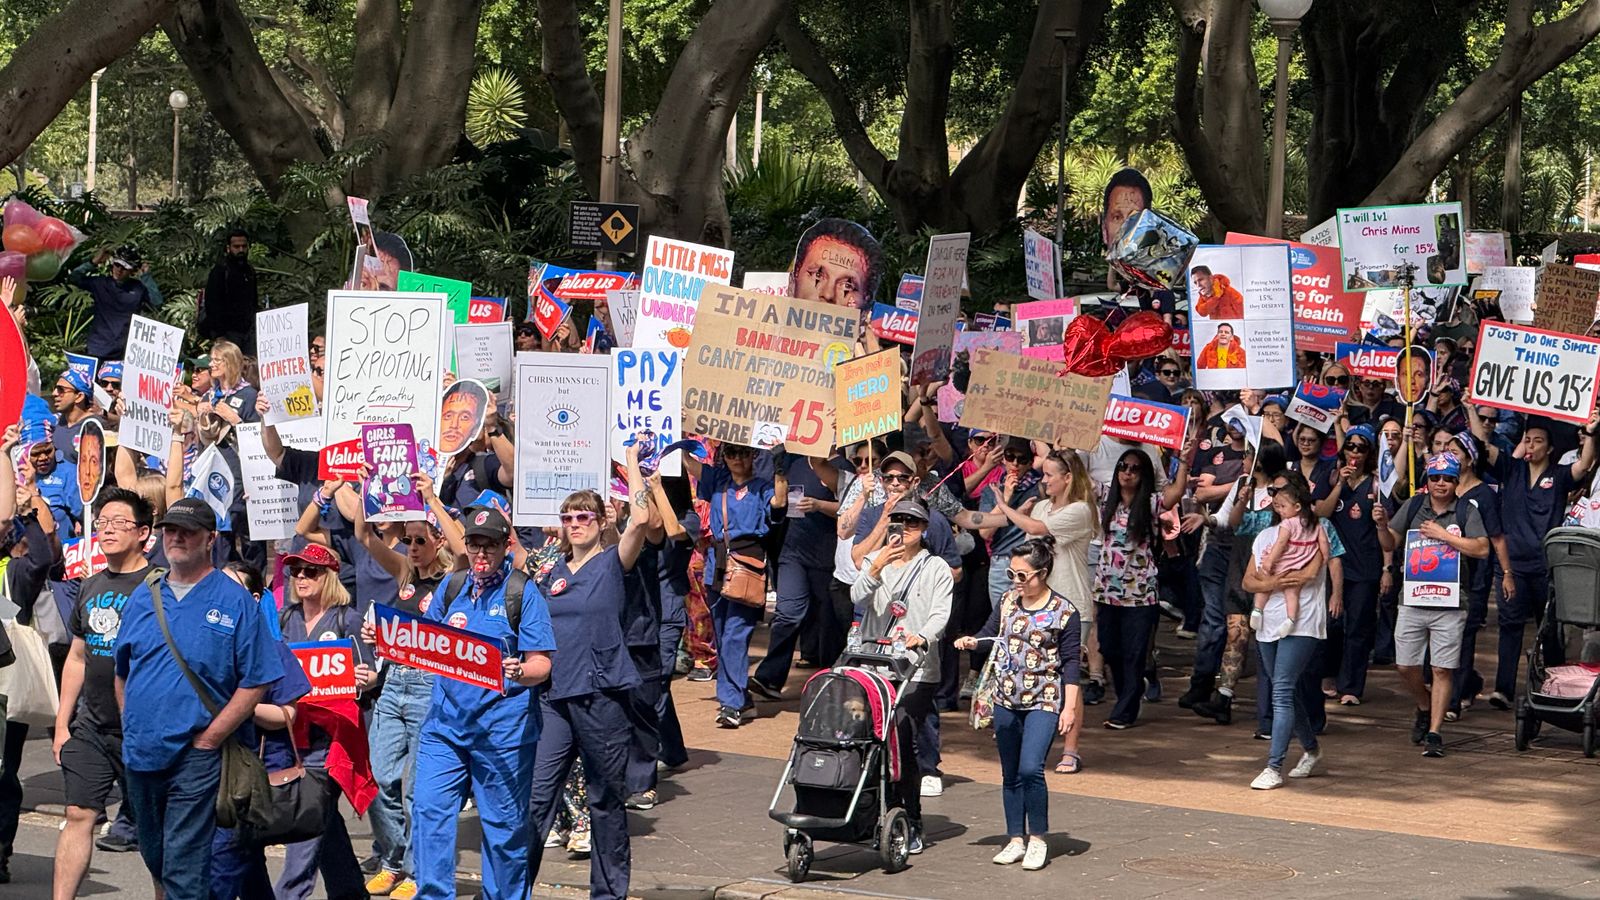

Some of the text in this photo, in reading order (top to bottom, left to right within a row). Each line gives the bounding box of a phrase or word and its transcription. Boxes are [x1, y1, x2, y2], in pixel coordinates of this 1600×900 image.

[1344, 212, 1387, 223] I will 1v1
[1311, 228, 1330, 244] RATIOS
[1362, 225, 1420, 236] Chris Minns
[822, 249, 854, 268] CLOWN
[1393, 244, 1436, 254] for 15%
[652, 240, 730, 279] LITTLE MISS
[595, 278, 616, 289] us
[1293, 274, 1330, 288] cord
[620, 292, 633, 308] IF
[1308, 290, 1333, 305] for
[470, 304, 493, 318] us
[714, 292, 856, 338] I'M A NURSE
[1294, 304, 1344, 323] Health
[349, 304, 430, 346] STOP
[881, 311, 917, 332] Valu
[1323, 326, 1348, 335] BRANCH
[133, 320, 157, 344] THE
[1488, 327, 1598, 354] JUST DO ONE SIMPLE
[260, 334, 301, 358] ARE YOU A
[736, 327, 820, 359] BANKRUPT
[126, 343, 176, 377] SMALLEST
[866, 355, 892, 372] not a
[975, 350, 990, 366] I
[1349, 348, 1396, 367] Value
[1515, 347, 1560, 367] THING
[617, 350, 678, 387] PAY
[745, 355, 799, 379] AFFORD
[800, 366, 816, 384] TO
[528, 375, 553, 384] CHRIS
[555, 376, 581, 384] MINNS
[746, 376, 785, 397] RENT
[847, 374, 889, 402] HERO
[1476, 362, 1593, 412] GIVE US 15%
[286, 395, 311, 413] PISS!
[335, 385, 415, 412] Our Empathy
[627, 389, 663, 411] ME
[685, 388, 782, 423] CAN ANYONE
[872, 399, 881, 410] a
[969, 384, 1097, 416] At Strangers Public
[124, 402, 149, 422] WHO
[332, 405, 400, 423] It's Financial
[1104, 398, 1172, 429] lue us
[1296, 405, 1316, 416] Value
[661, 416, 672, 430] A
[694, 414, 751, 443] SPARE
[842, 412, 898, 444] HUMAN
[983, 412, 1091, 445] THERAPY
[135, 425, 163, 451] LIVED
[366, 427, 395, 442] GIRLS
[1103, 425, 1174, 445] #nswnma #valueus
[326, 446, 365, 466] Value
[373, 445, 408, 464] FAIR
[378, 462, 413, 479] PAY!
[1409, 540, 1422, 548] WE
[1410, 545, 1456, 575] 15%
[1413, 586, 1436, 595] Value
[86, 591, 128, 614] FIGH
[381, 614, 450, 655] Value
[455, 640, 487, 665] us
[309, 653, 345, 677] us
[409, 653, 498, 686] #nswnma #valueus
